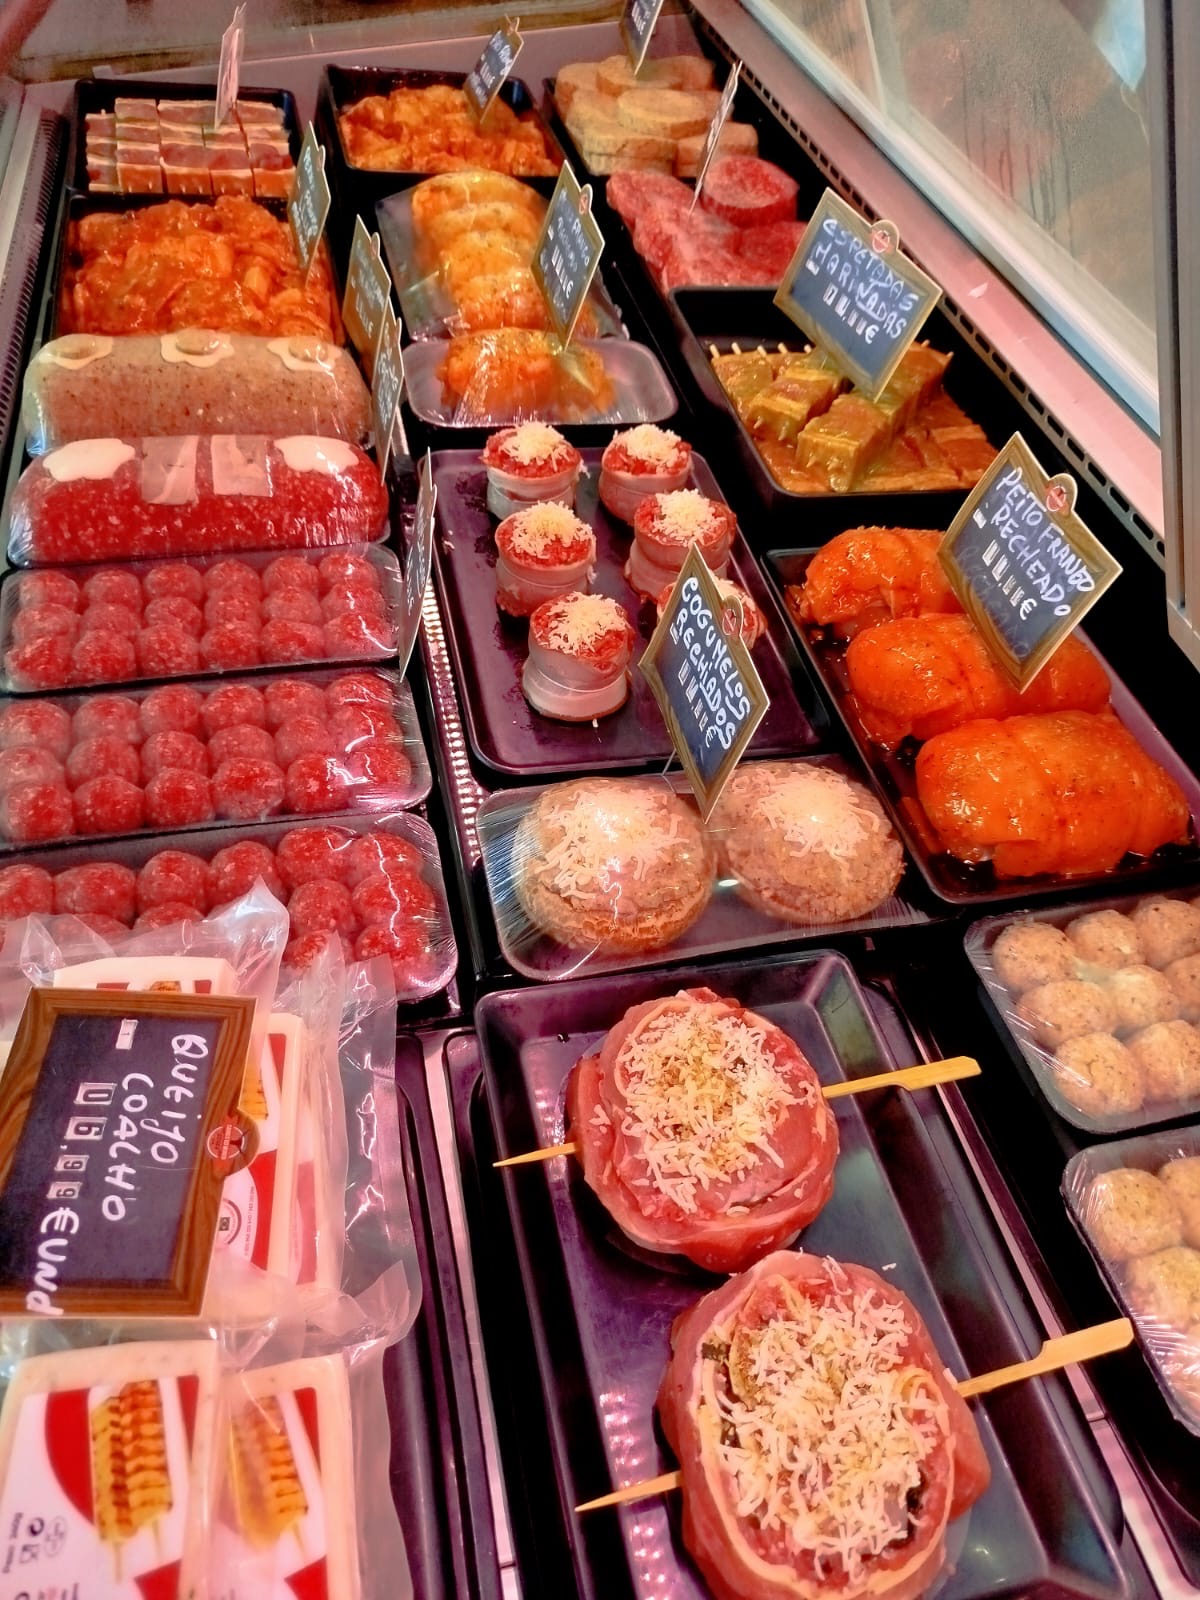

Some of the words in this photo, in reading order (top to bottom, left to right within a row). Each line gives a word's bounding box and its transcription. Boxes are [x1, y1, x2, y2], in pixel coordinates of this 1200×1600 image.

[812, 241, 907, 339] MARINADAS
[823, 219, 919, 312] ESPETADAS
[996, 466, 1047, 527] PEITO
[991, 506, 1071, 616] RECHEADO
[681, 576, 751, 722] COGUMELOS
[102, 1072, 154, 1221] COALHO
[140, 1033, 209, 1163] QUEIJO
